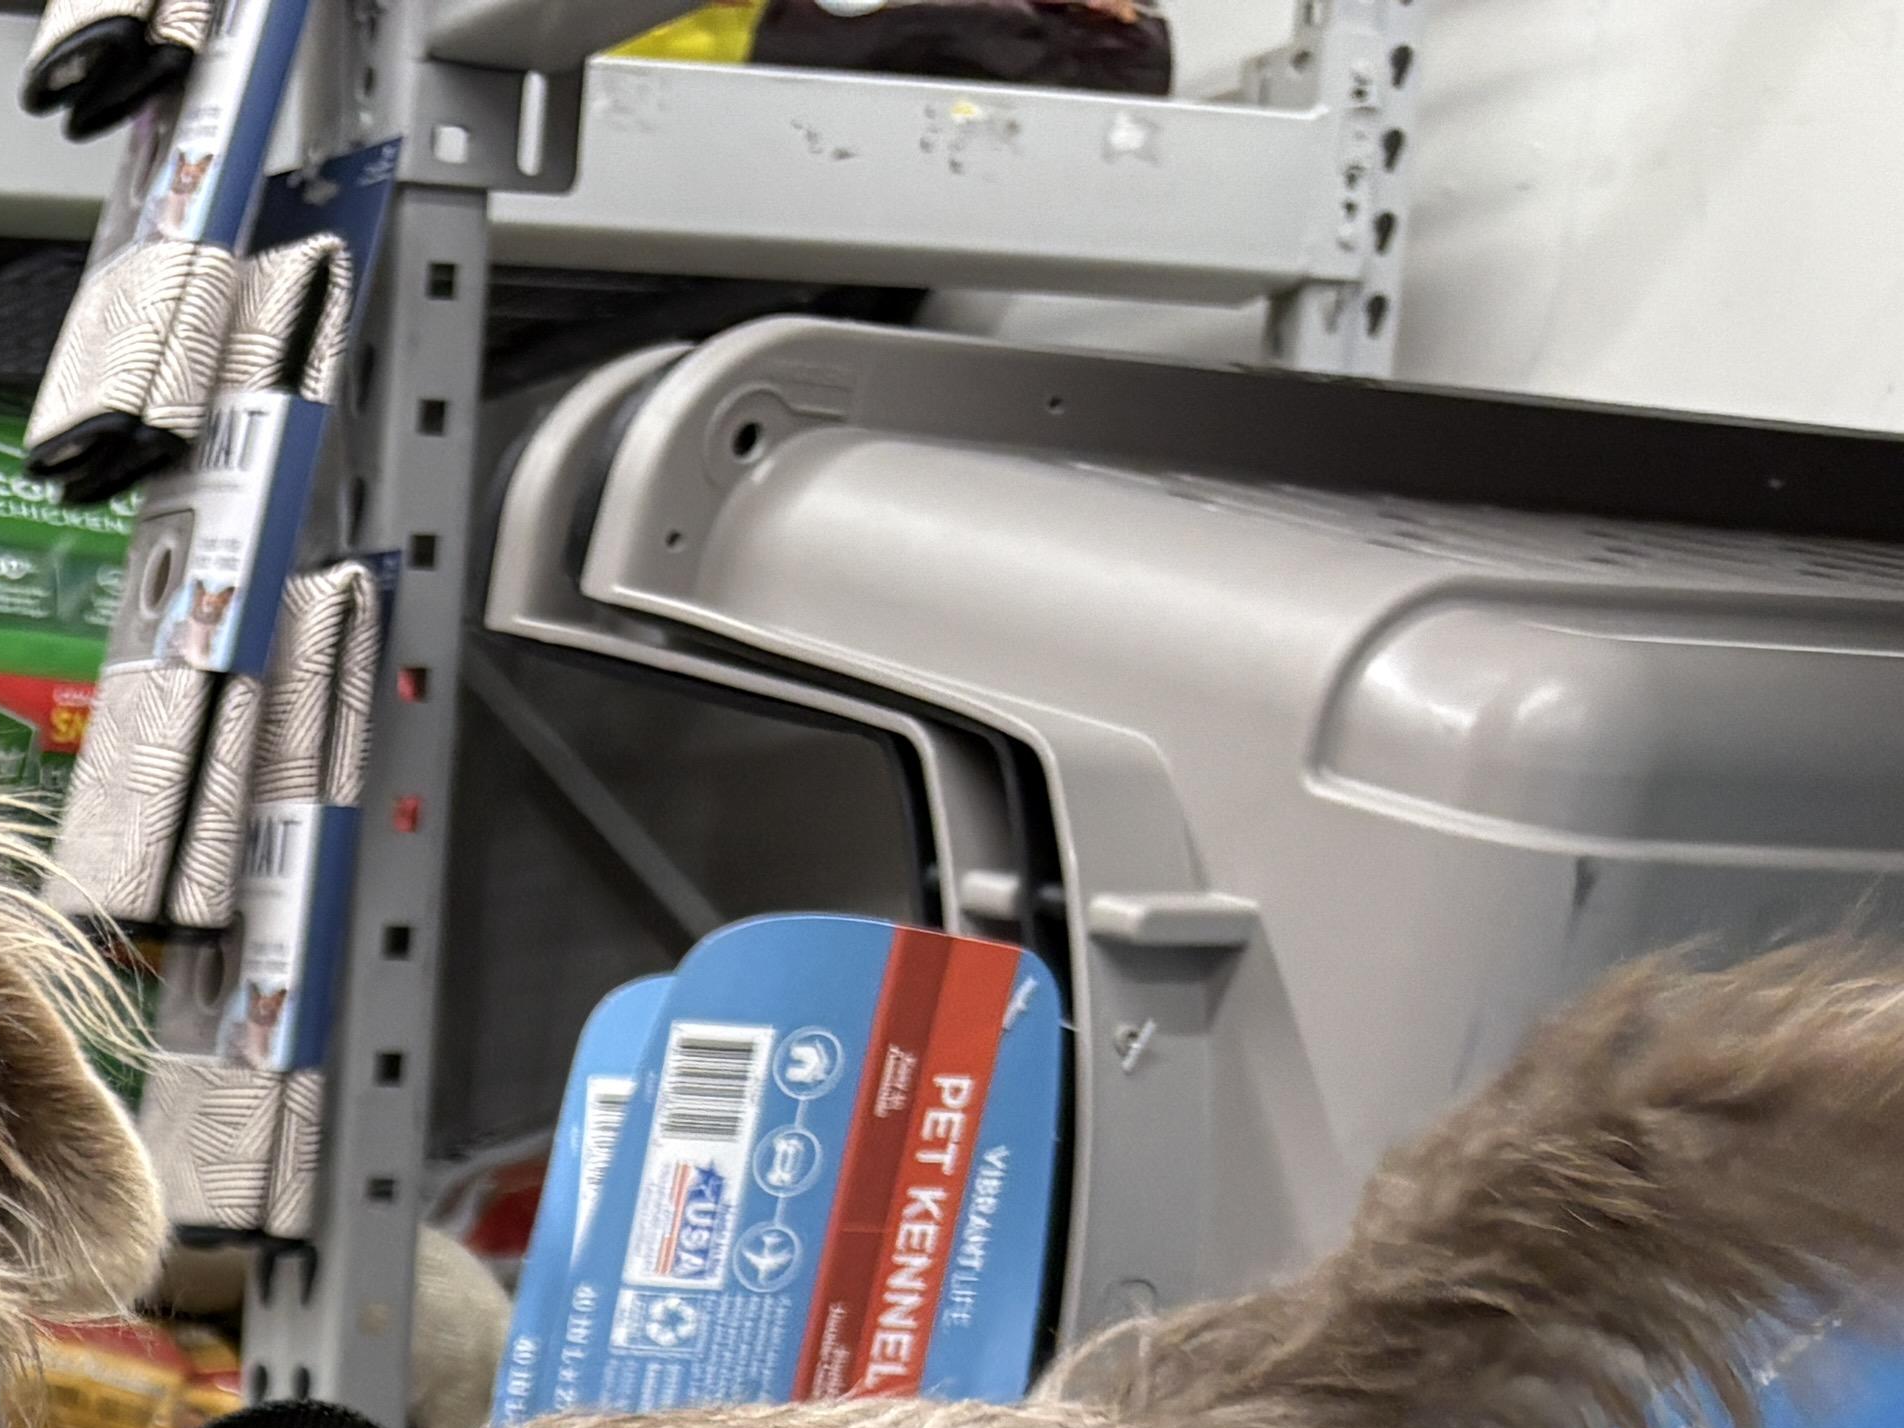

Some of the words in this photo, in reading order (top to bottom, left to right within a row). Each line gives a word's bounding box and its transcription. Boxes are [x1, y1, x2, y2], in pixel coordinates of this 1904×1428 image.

[916, 1073, 972, 1177] PET
[674, 1195, 720, 1279] USA
[956, 1145, 1011, 1272] VIBRANT
[864, 1185, 947, 1387] KENNEL
[943, 1271, 980, 1328] LIFE
